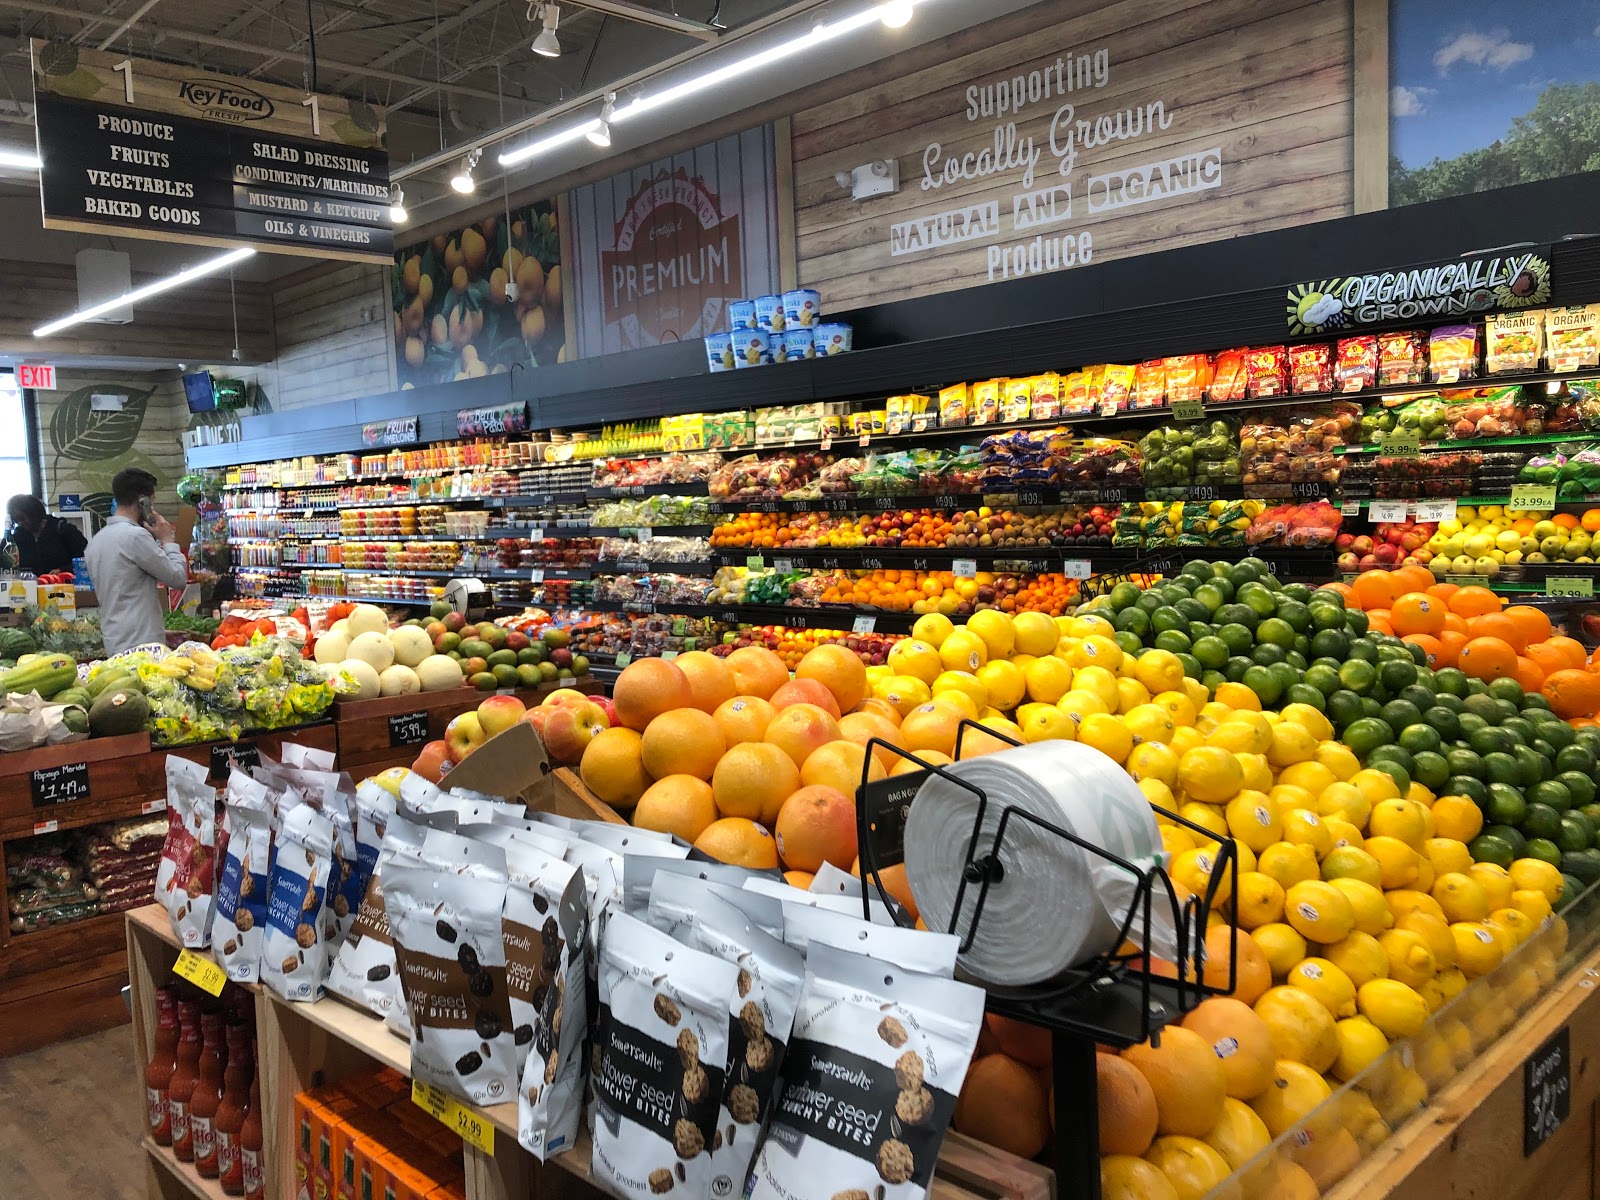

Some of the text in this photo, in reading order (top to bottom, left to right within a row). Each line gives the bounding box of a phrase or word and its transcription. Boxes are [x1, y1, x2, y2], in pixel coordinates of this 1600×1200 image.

[112, 59, 135, 104] 1
[965, 48, 1110, 122] Supporting
[98, 114, 174, 142] PRODUCE
[208, 109, 240, 121] FRESH
[302, 94, 320, 136] 1
[110, 144, 170, 168] FRUITS
[252, 142, 370, 175] SALAD DRESSING
[919, 99, 1174, 191] Locally Grown
[86, 168, 195, 198] VEGETABLES
[235, 164, 389, 199] CONDIMENTS/MARINADES
[84, 196, 201, 226] BAKED GOODS
[248, 192, 381, 222] MUSTARD & KETCHUP
[891, 147, 1222, 257] NATURAL AND ORGANIC
[264, 219, 371, 244] OILS & VINEGARS
[987, 231, 1094, 282] Produce
[611, 235, 730, 309] PREMIUM
[1343, 252, 1534, 309] ORGANICALLY
[1358, 292, 1471, 324] GROWN
[1553, 312, 1597, 326] ORGANIC
[20, 364, 52, 389] EXIT
[386, 419, 416, 434] FRUITS
[474, 409, 496, 425] Berry
[483, 417, 506, 434] Patch
[1177, 407, 1199, 418] $3.99
[387, 431, 416, 444] MELONS
[34, 770, 60, 783] Papaya
[887, 790, 902, 803] BAG
[510, 961, 536, 982] seed
[430, 1006, 468, 1021] BITES
[611, 1031, 662, 1073] Somersaults
[602, 1054, 676, 1112] flower seed
[811, 1054, 872, 1091] Somersaults
[458, 1109, 482, 1137] $2.99
[636, 1098, 671, 1127] BITES
[834, 1100, 883, 1133] seed
[826, 1115, 874, 1147] BITES
[616, 1171, 647, 1191] goodness
